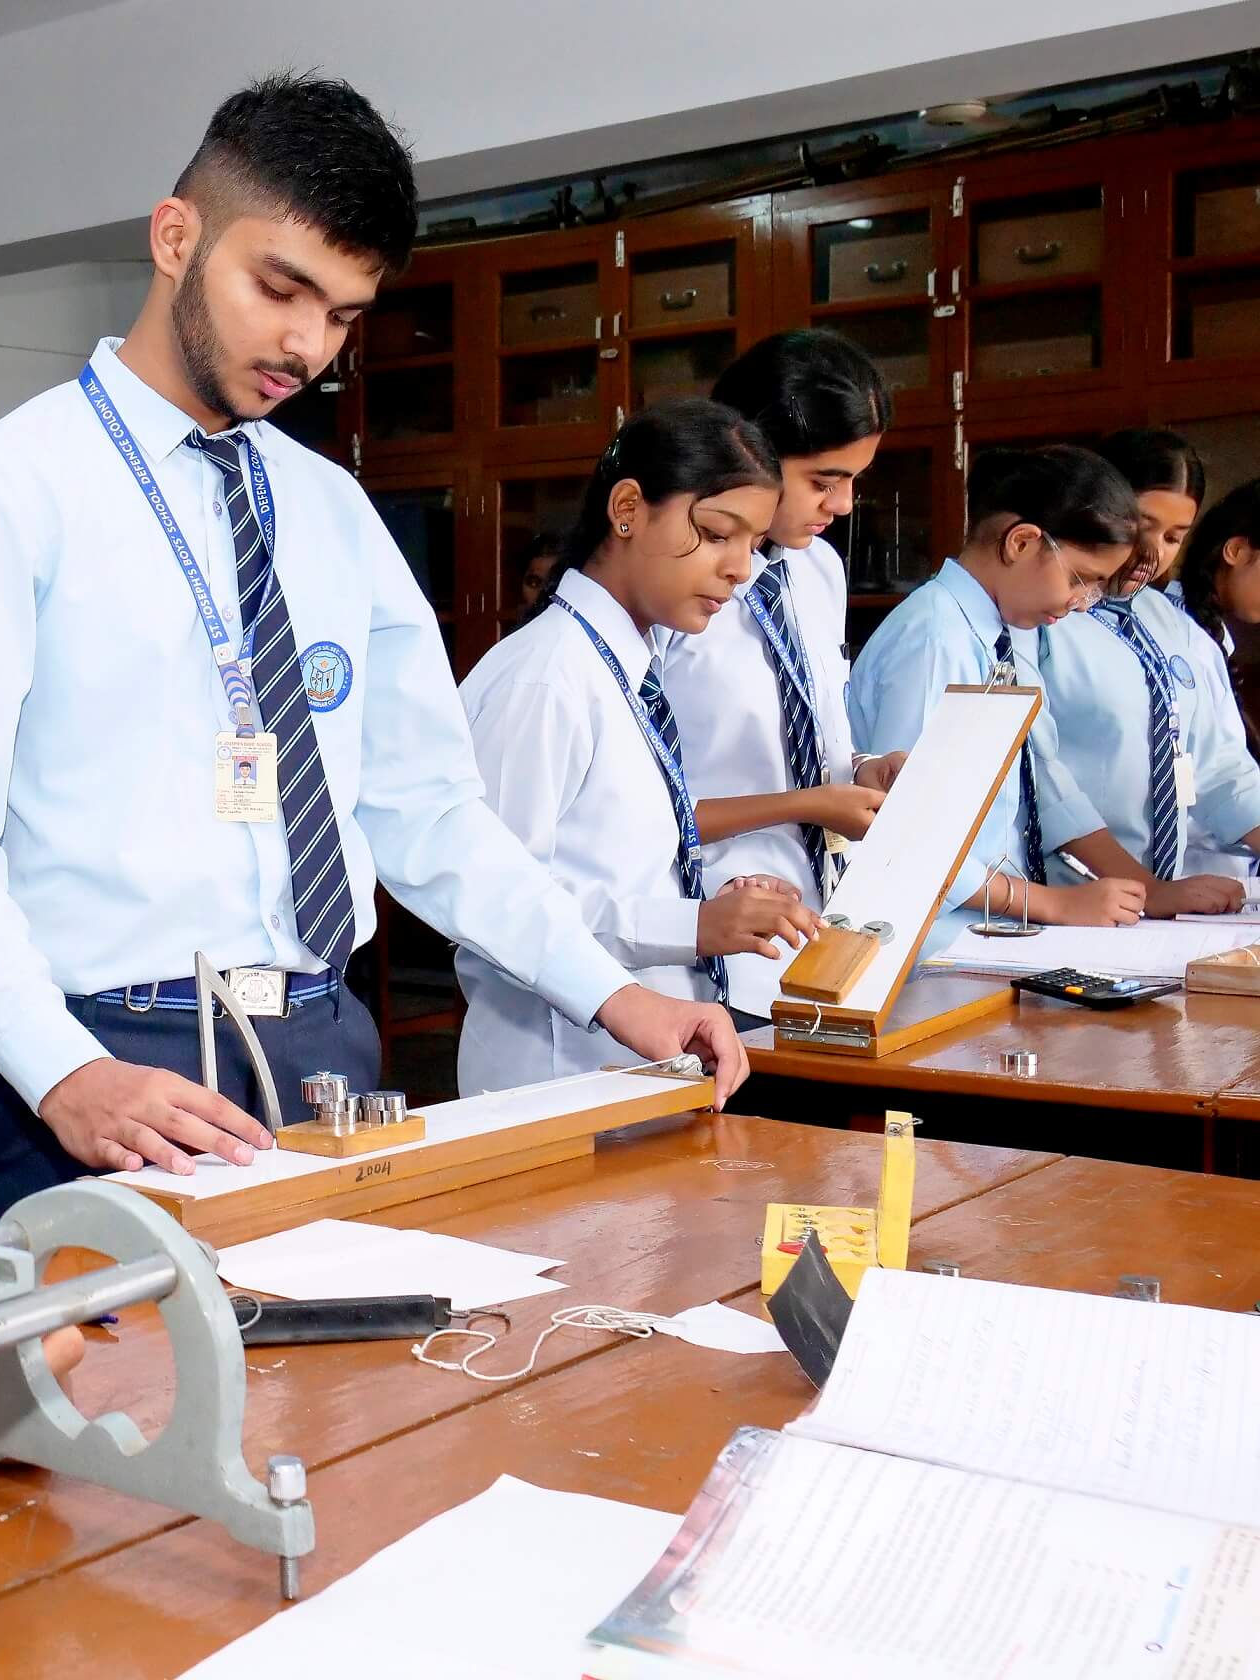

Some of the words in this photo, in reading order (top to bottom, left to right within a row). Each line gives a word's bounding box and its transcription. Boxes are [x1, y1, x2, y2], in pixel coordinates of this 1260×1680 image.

[119, 438, 151, 485] DEFENCE
[148, 485, 177, 534] SCHOOL,
[253, 470, 270, 514] DEFENCE
[188, 568, 216, 619] JOSEPH'S
[209, 622, 223, 639] ST.
[355, 1161, 392, 1183] 2004
